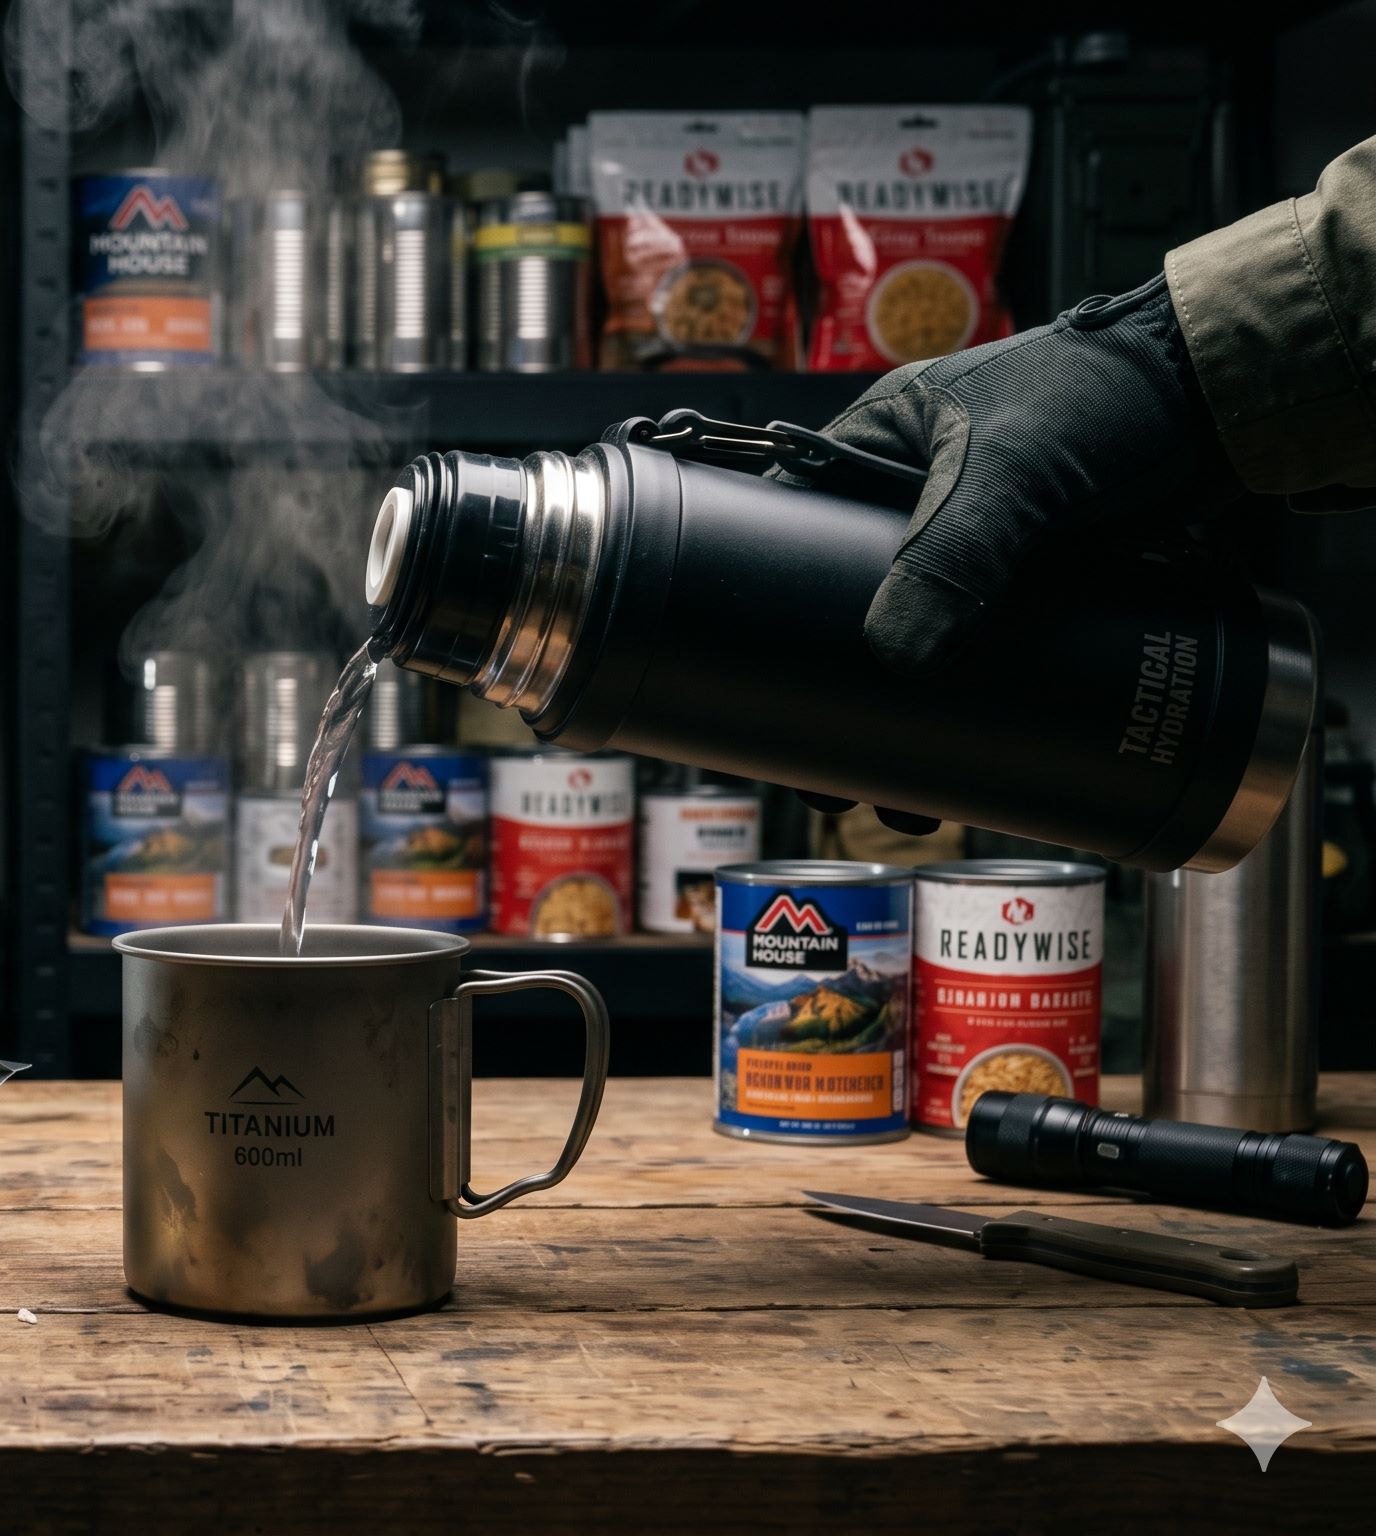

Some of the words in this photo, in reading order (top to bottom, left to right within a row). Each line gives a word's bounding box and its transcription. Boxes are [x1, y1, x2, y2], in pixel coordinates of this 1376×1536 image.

[1118, 631, 1171, 754] TACTICAL
[1150, 634, 1199, 764] HYDRATION
[752, 934, 839, 951] MOUNTAIN
[940, 929, 1092, 962] READYWISE
[752, 949, 806, 965] HOUSE
[204, 1111, 335, 1137] TITANIUM
[234, 1146, 303, 1167] 600ml
